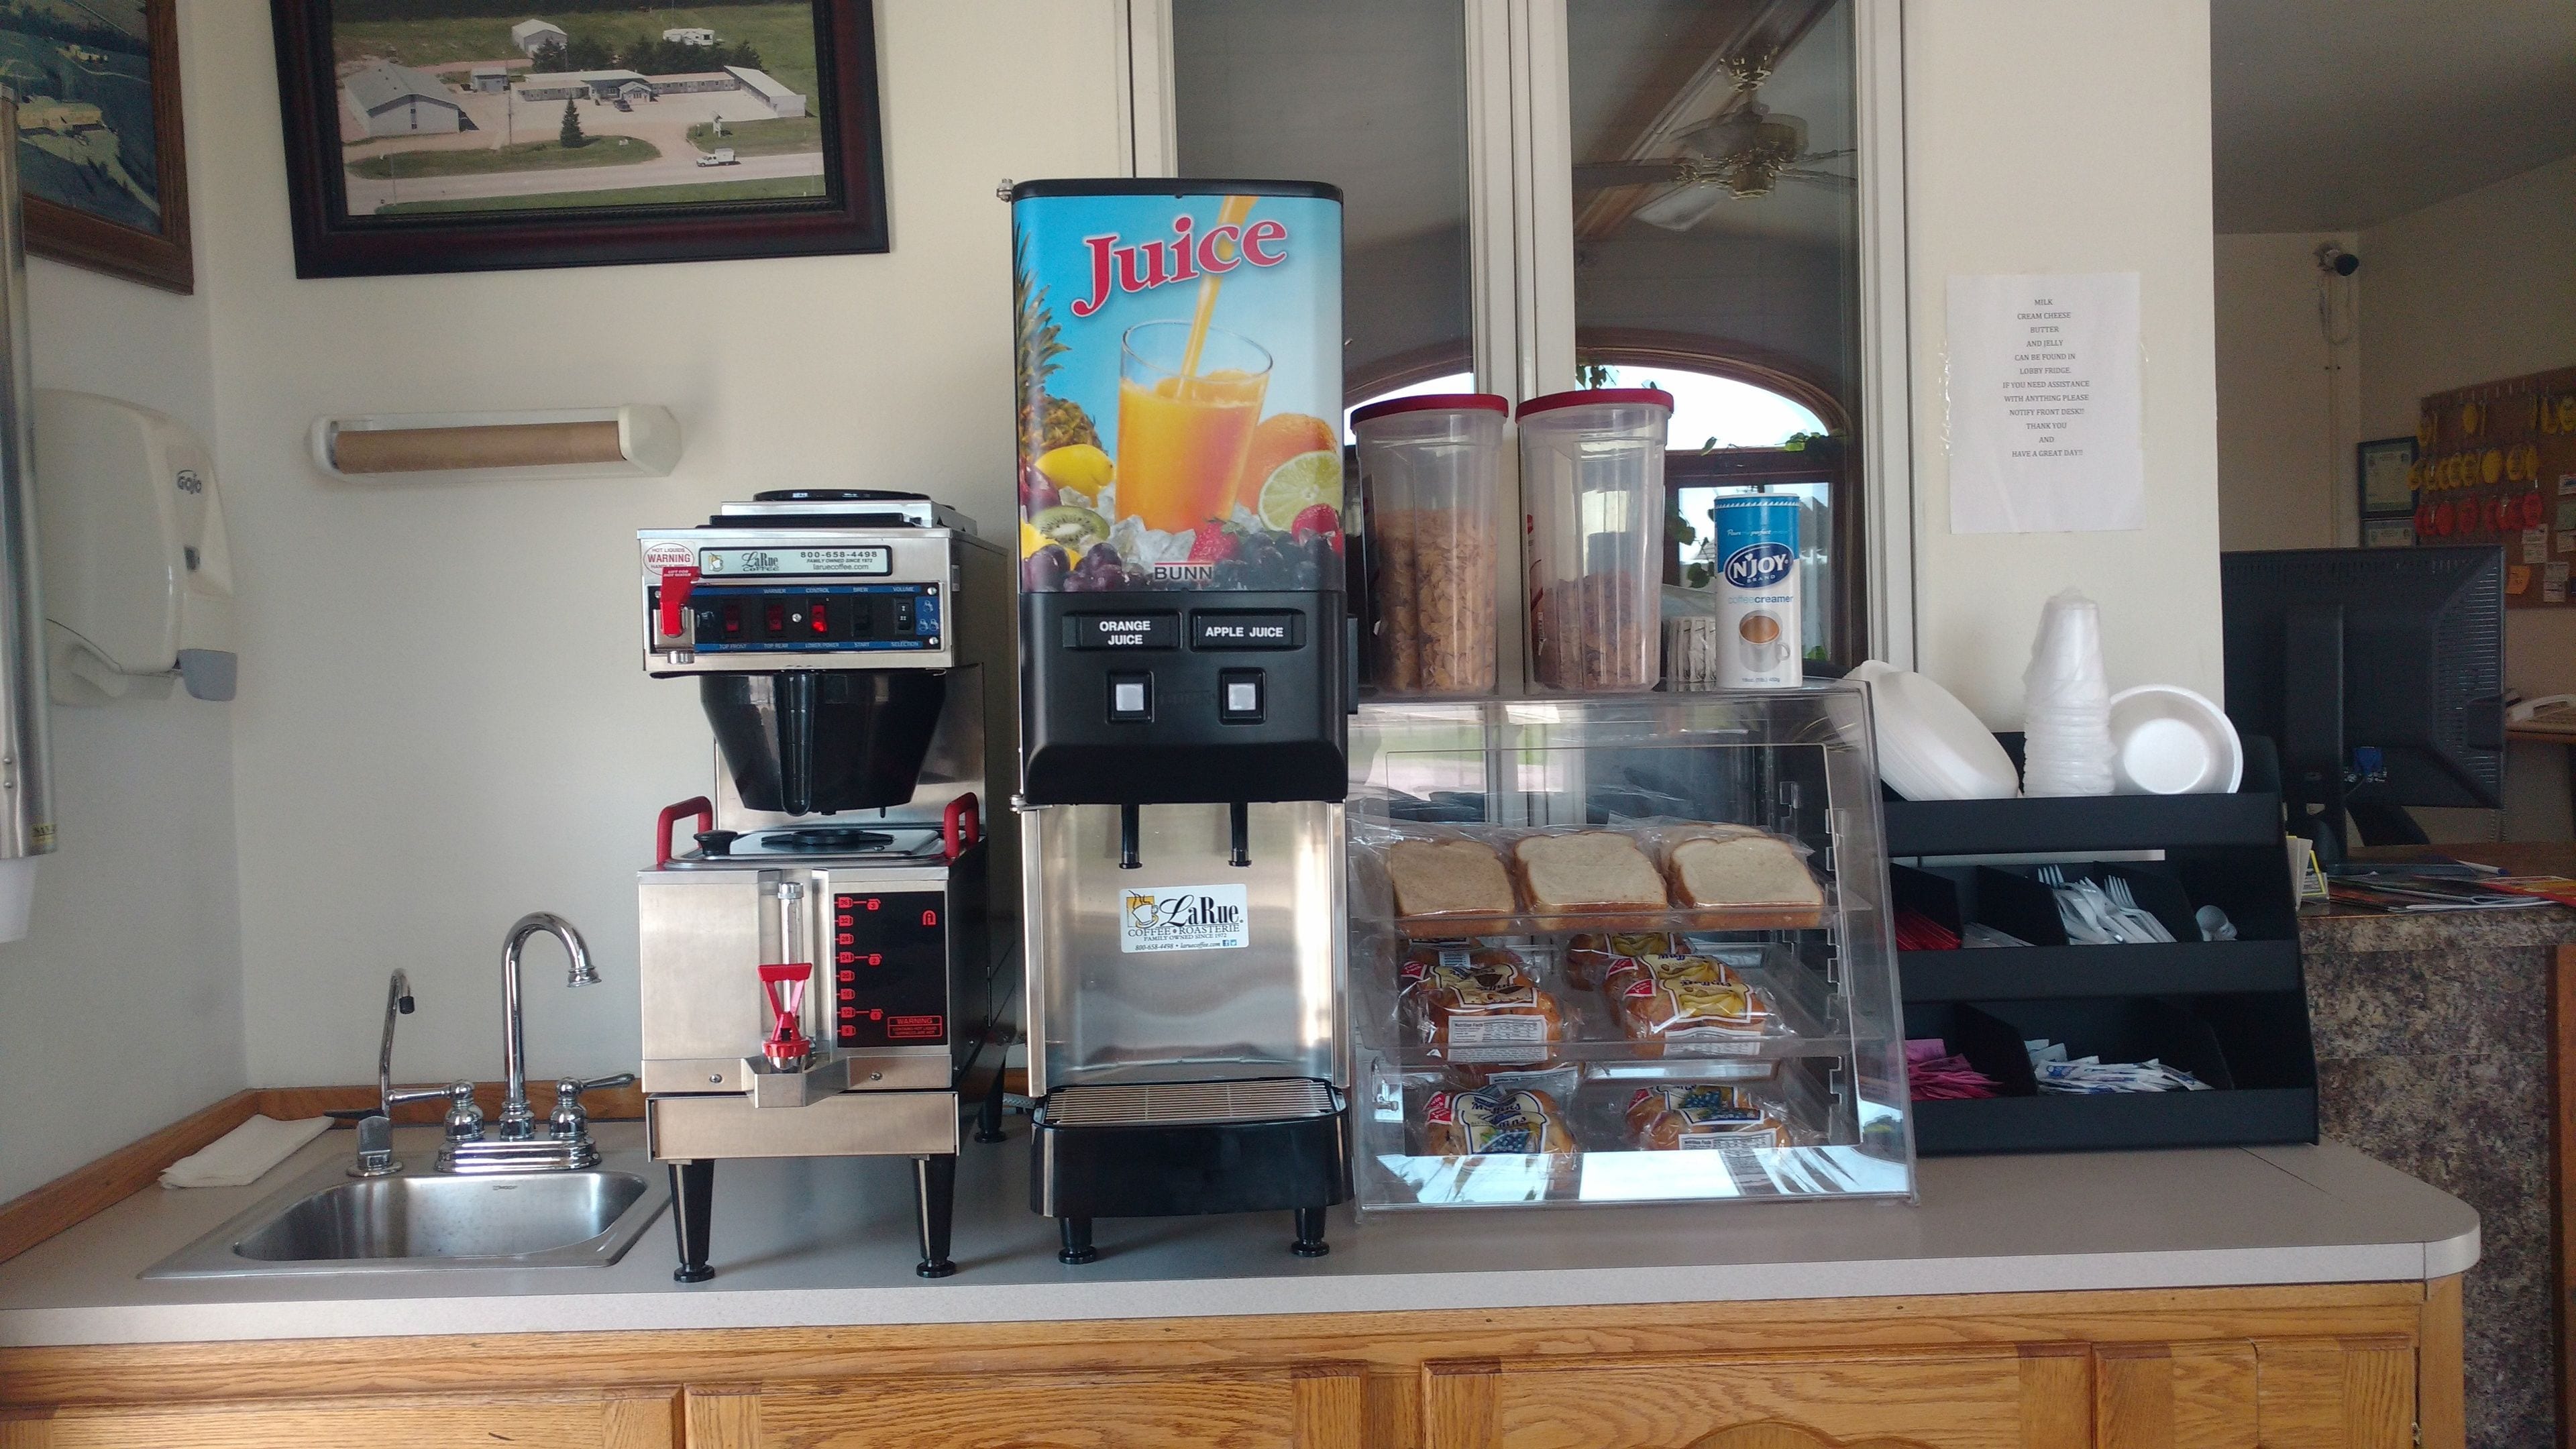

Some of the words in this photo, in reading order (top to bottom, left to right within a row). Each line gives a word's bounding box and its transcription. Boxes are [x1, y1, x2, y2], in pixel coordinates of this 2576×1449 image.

[1071, 217, 1287, 317] Juice
[647, 553, 690, 563] WARNING
[741, 551, 779, 568] LaRue
[1155, 566, 1213, 581] BUNN
[1747, 575, 1776, 584] BRAND
[1099, 621, 1151, 632] ORANGE
[1205, 627, 1244, 638] APPLE
[1249, 627, 1283, 638] JUICE
[1108, 635, 1143, 645] JUICE
[1159, 894, 1240, 927] LaRue
[1128, 927, 1171, 937] COFFEE
[1179, 924, 1240, 934] ROASTERIE
